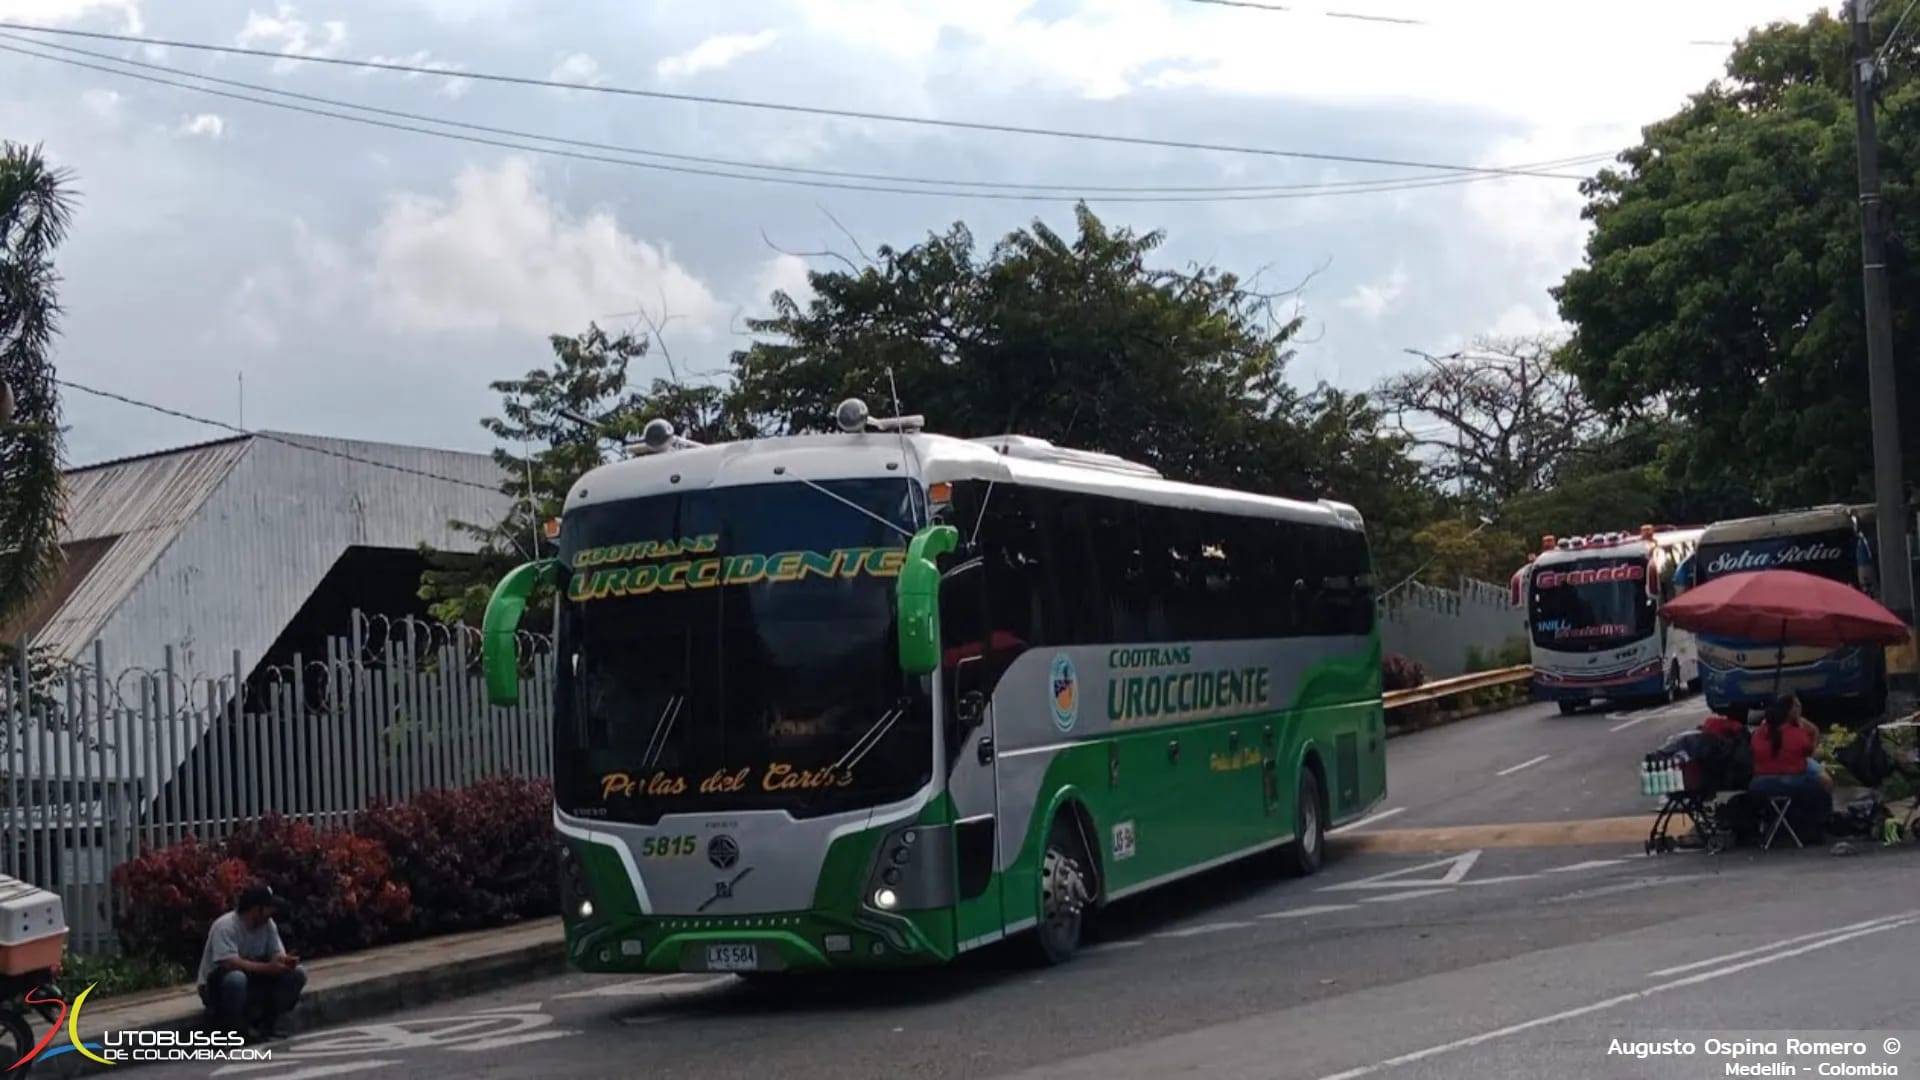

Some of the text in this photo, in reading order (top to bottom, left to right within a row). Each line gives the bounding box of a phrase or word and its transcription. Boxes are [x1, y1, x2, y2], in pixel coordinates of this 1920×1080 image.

[572, 534, 719, 566] COOTRANS
[568, 547, 905, 601] UROCCIDENTE
[1536, 561, 1645, 589] Granada
[1109, 646, 1191, 668] COOTRANS
[1107, 667, 1269, 721] UROCCIDENTE
[700, 766, 750, 793] del
[642, 835, 696, 858] 5815
[708, 946, 730, 963] LXS
